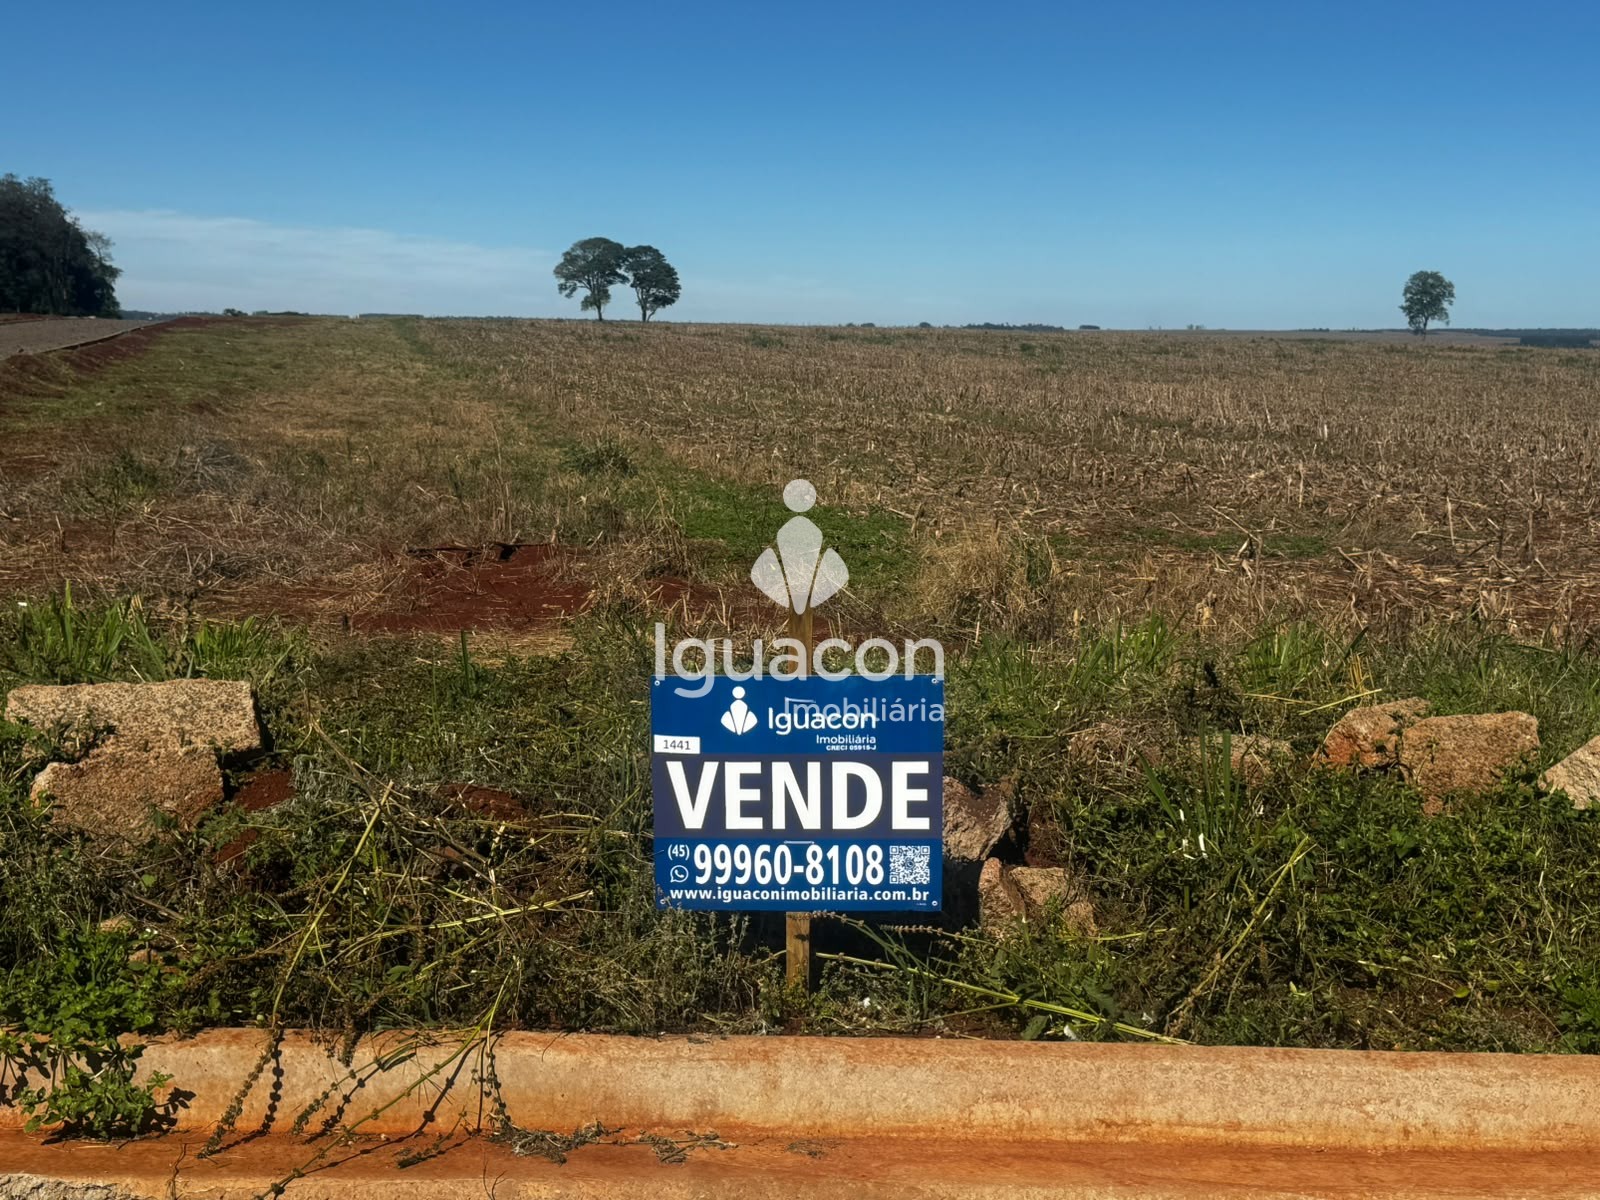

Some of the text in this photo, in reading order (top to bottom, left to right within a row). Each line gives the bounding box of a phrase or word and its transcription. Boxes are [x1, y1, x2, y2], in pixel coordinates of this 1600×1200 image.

[768, 707, 876, 735] Iguacon
[663, 739, 691, 751] 1441
[816, 734, 876, 745] Imobiliária
[666, 761, 930, 830] VENDE
[667, 843, 884, 885] (45) 99960-8108
[669, 887, 929, 903] www.iguaconimobiliaria.com.br
